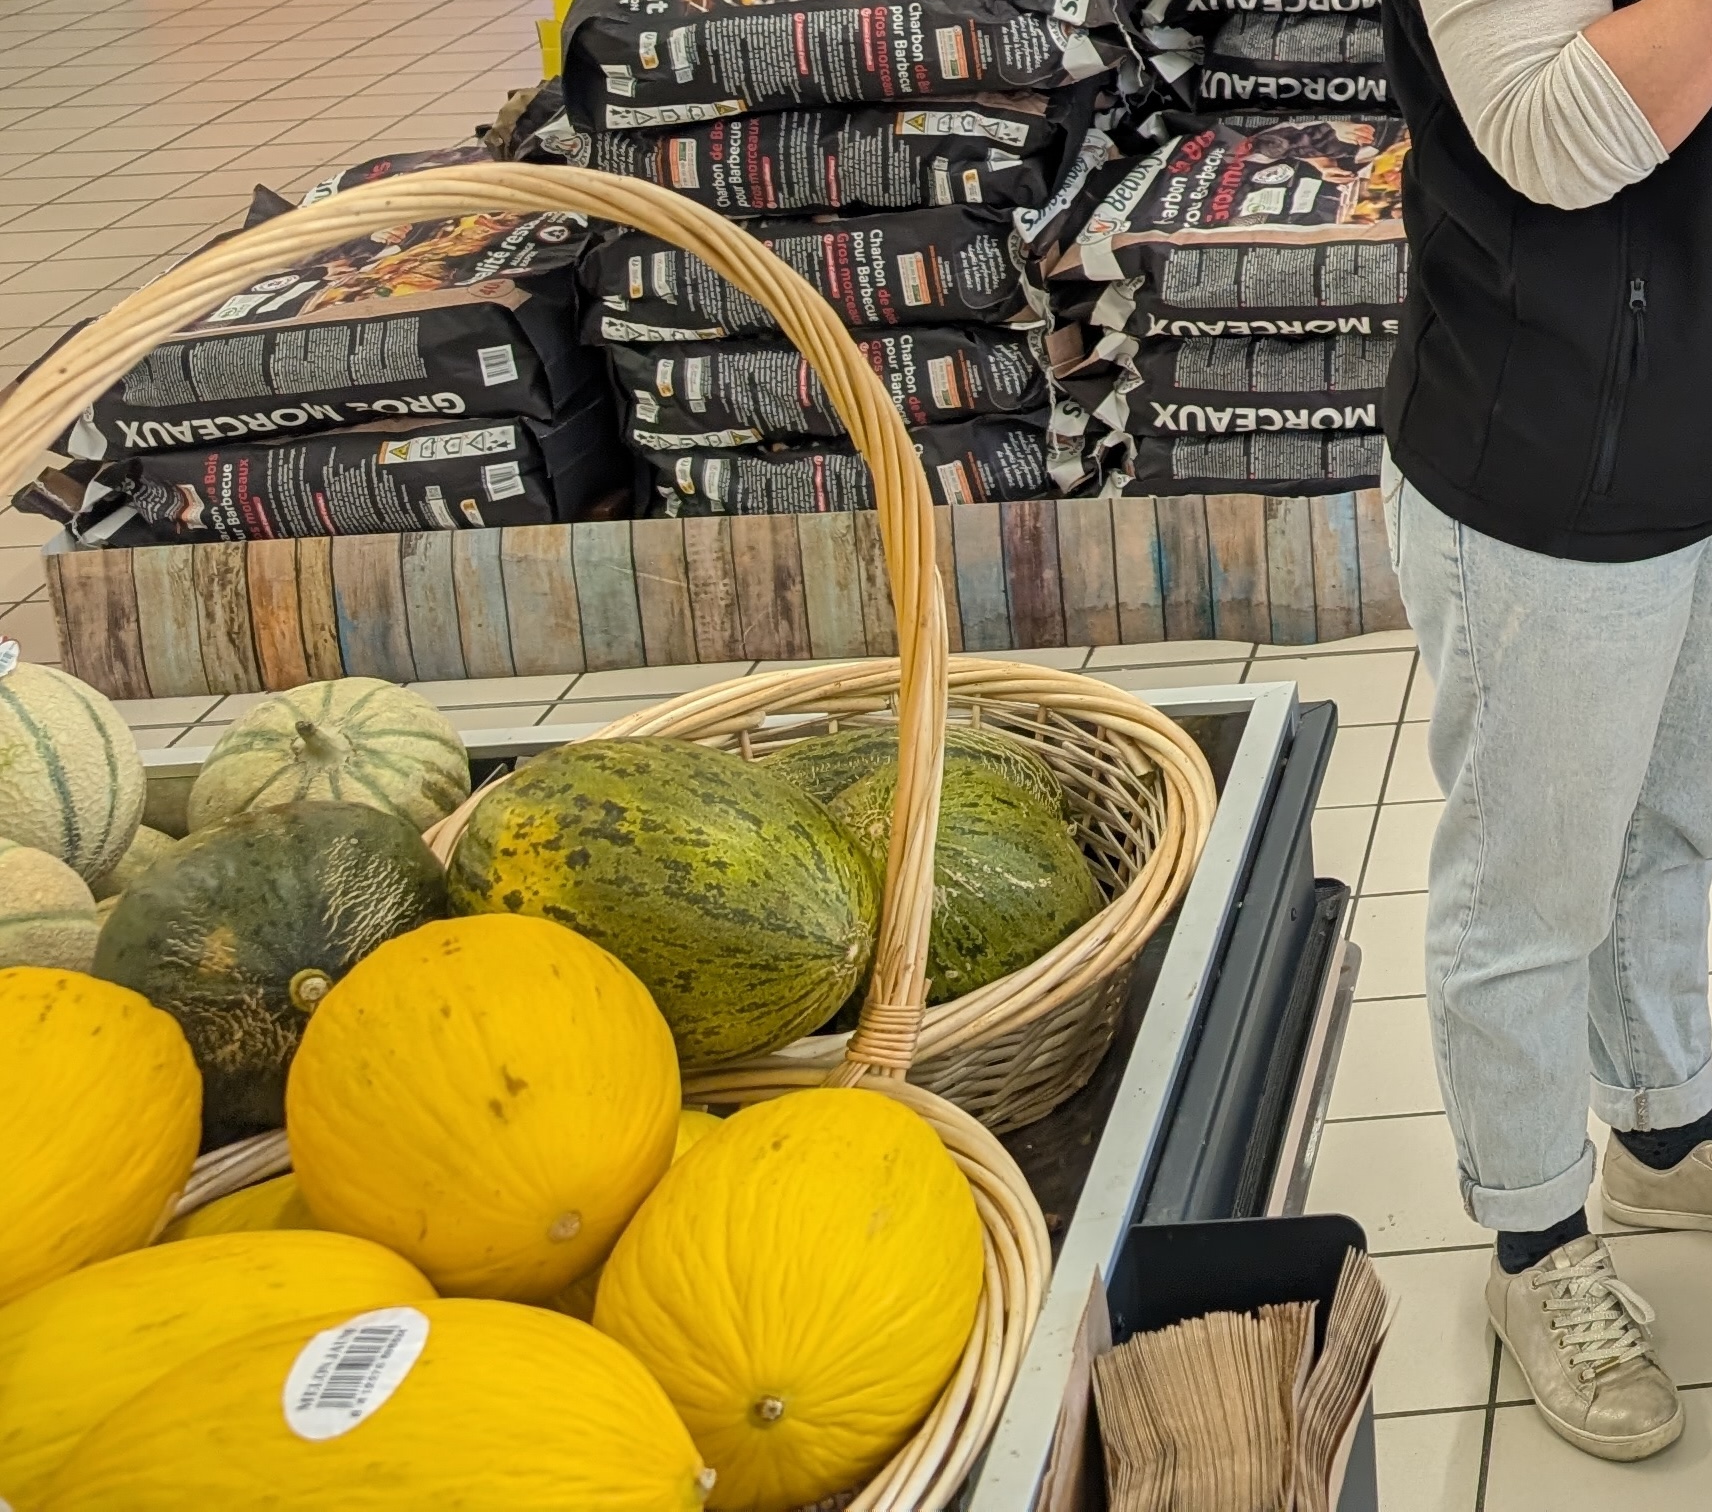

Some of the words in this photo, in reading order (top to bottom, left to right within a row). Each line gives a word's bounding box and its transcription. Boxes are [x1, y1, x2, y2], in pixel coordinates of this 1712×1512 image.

[874, 6, 888, 37] Gros
[889, 5, 905, 37] pour
[908, 2, 924, 62] Charbon
[914, 63, 928, 79] de
[709, 141, 724, 161] de
[729, 121, 743, 184] Barbecue
[713, 162, 731, 208] Charbon
[731, 183, 750, 208] pour
[837, 232, 850, 266] Gros
[851, 231, 868, 264] pour
[869, 229, 886, 287] Charbon
[877, 288, 890, 307] de
[1146, 312, 1371, 338] MORCEAUX
[870, 340, 884, 373] Gros
[882, 337, 900, 371] pour
[900, 333, 918, 394] Charbon
[115, 400, 345, 449] MORCEAUX
[1149, 401, 1376, 433] MORCEAUX
[203, 452, 220, 484] Bois
[220, 462, 242, 531] Barbecue
[236, 457, 260, 524] morceaux
